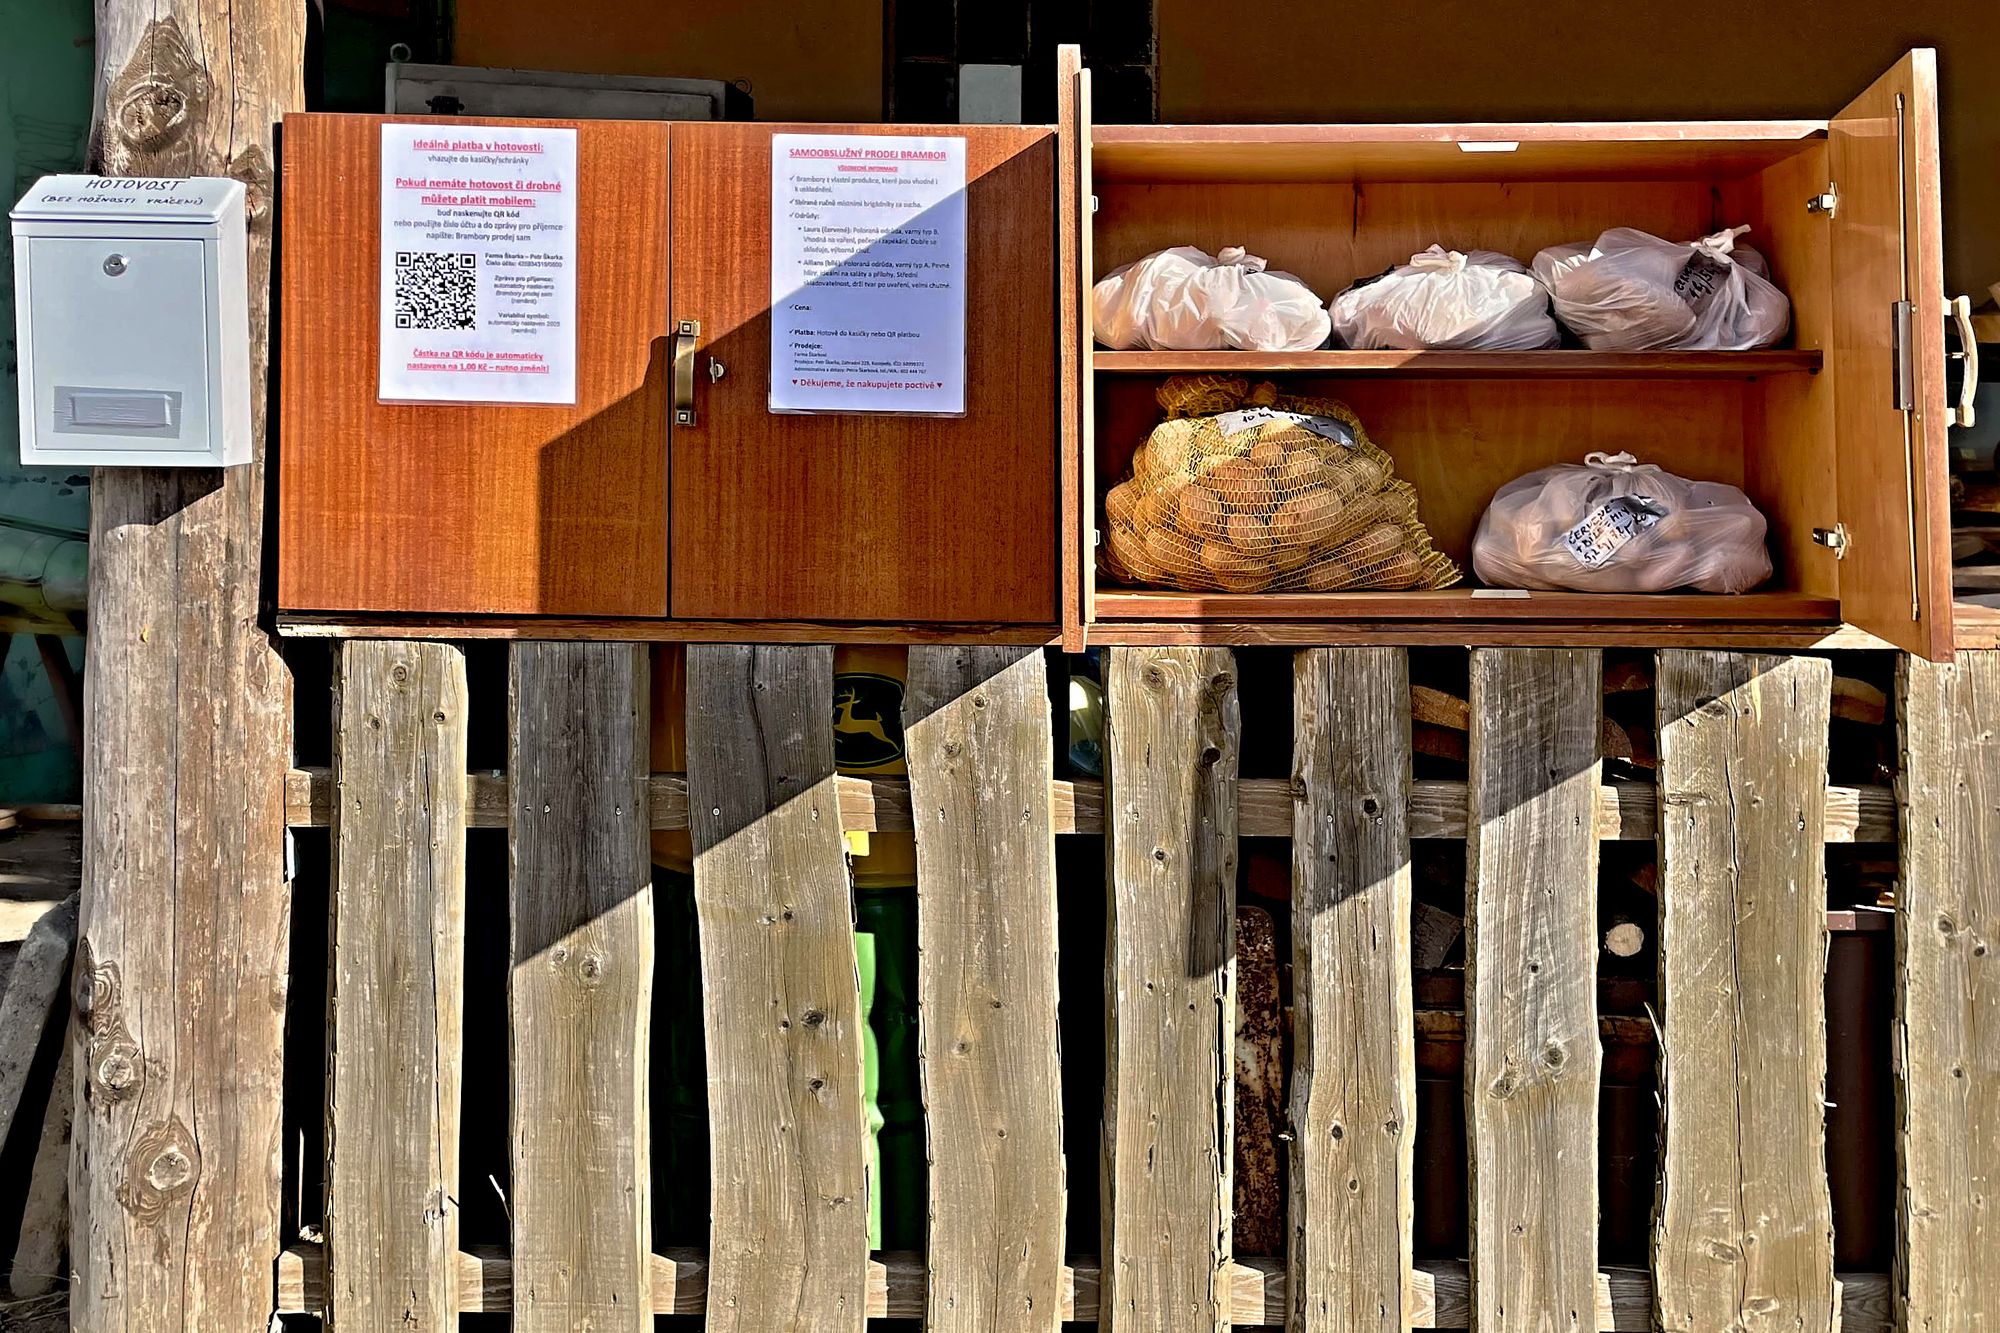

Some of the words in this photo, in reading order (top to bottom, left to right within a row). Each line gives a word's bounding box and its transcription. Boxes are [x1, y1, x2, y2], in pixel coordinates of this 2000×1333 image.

[413, 140, 449, 150] Ideálně
[452, 141, 483, 152] platba
[790, 148, 863, 159] SAMOOBSLUŽNÝ
[865, 151, 898, 160] PRODEJ
[901, 151, 946, 161] BRAMBOR
[428, 156, 458, 164] vhazujte
[470, 156, 529, 165] kasičky/schránky
[85, 179, 186, 191] HOTOVOST
[396, 178, 427, 187] Pokud
[430, 178, 467, 188] nemáte
[470, 179, 512, 189] hotovost
[515, 180, 523, 189] či
[526, 180, 561, 190] drobné
[851, 177, 880, 185] produkce,
[78, 194, 135, 203] MOŽNOSTI
[421, 195, 458, 205] můžete
[461, 195, 486, 206] platit
[489, 196, 536, 207] mobilem:
[453, 210, 492, 218] naskenujte
[795, 212, 819, 220] Odrůdy:
[413, 220, 441, 228] použijte
[460, 220, 476, 228] účtu
[484, 221, 493, 229] do
[495, 222, 517, 230] zprávy
[533, 223, 563, 231] příjemce
[426, 232, 453, 240] napište:
[456, 232, 490, 241] Brambory
[492, 234, 515, 242] prodej
[413, 349, 438, 358] Částka
[486, 352, 493, 360] je
[496, 352, 543, 360] automaticky
[460, 363, 476, 371] 1,00
[478, 363, 487, 371] Kč
[801, 379, 844, 388] Děkujeme,
[857, 380, 902, 389] nakupujete
[905, 381, 935, 390] poctivě
